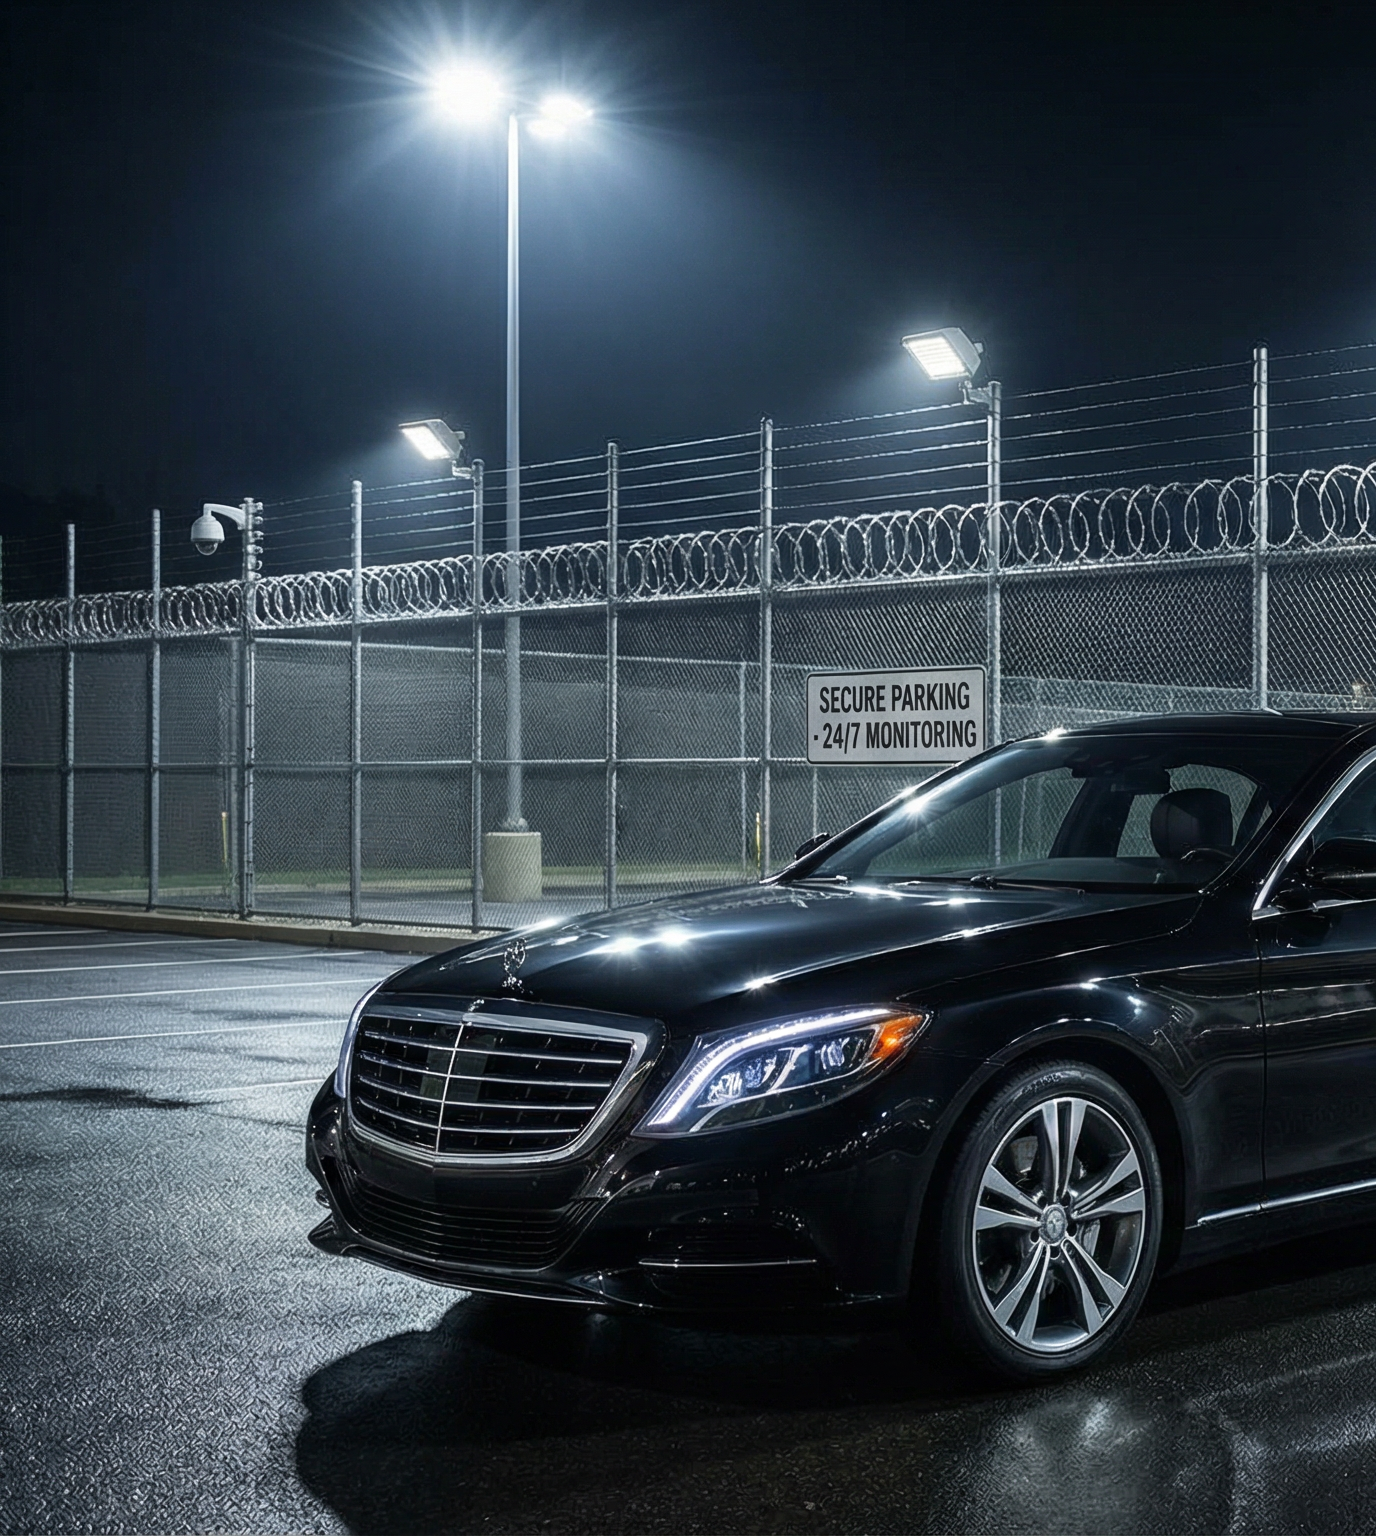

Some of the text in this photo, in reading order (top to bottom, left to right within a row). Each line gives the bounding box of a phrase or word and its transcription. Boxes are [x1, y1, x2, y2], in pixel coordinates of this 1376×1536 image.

[819, 681, 970, 714] SECURE PARKING
[822, 721, 861, 755] 24/7
[865, 719, 977, 749] MONITORING
